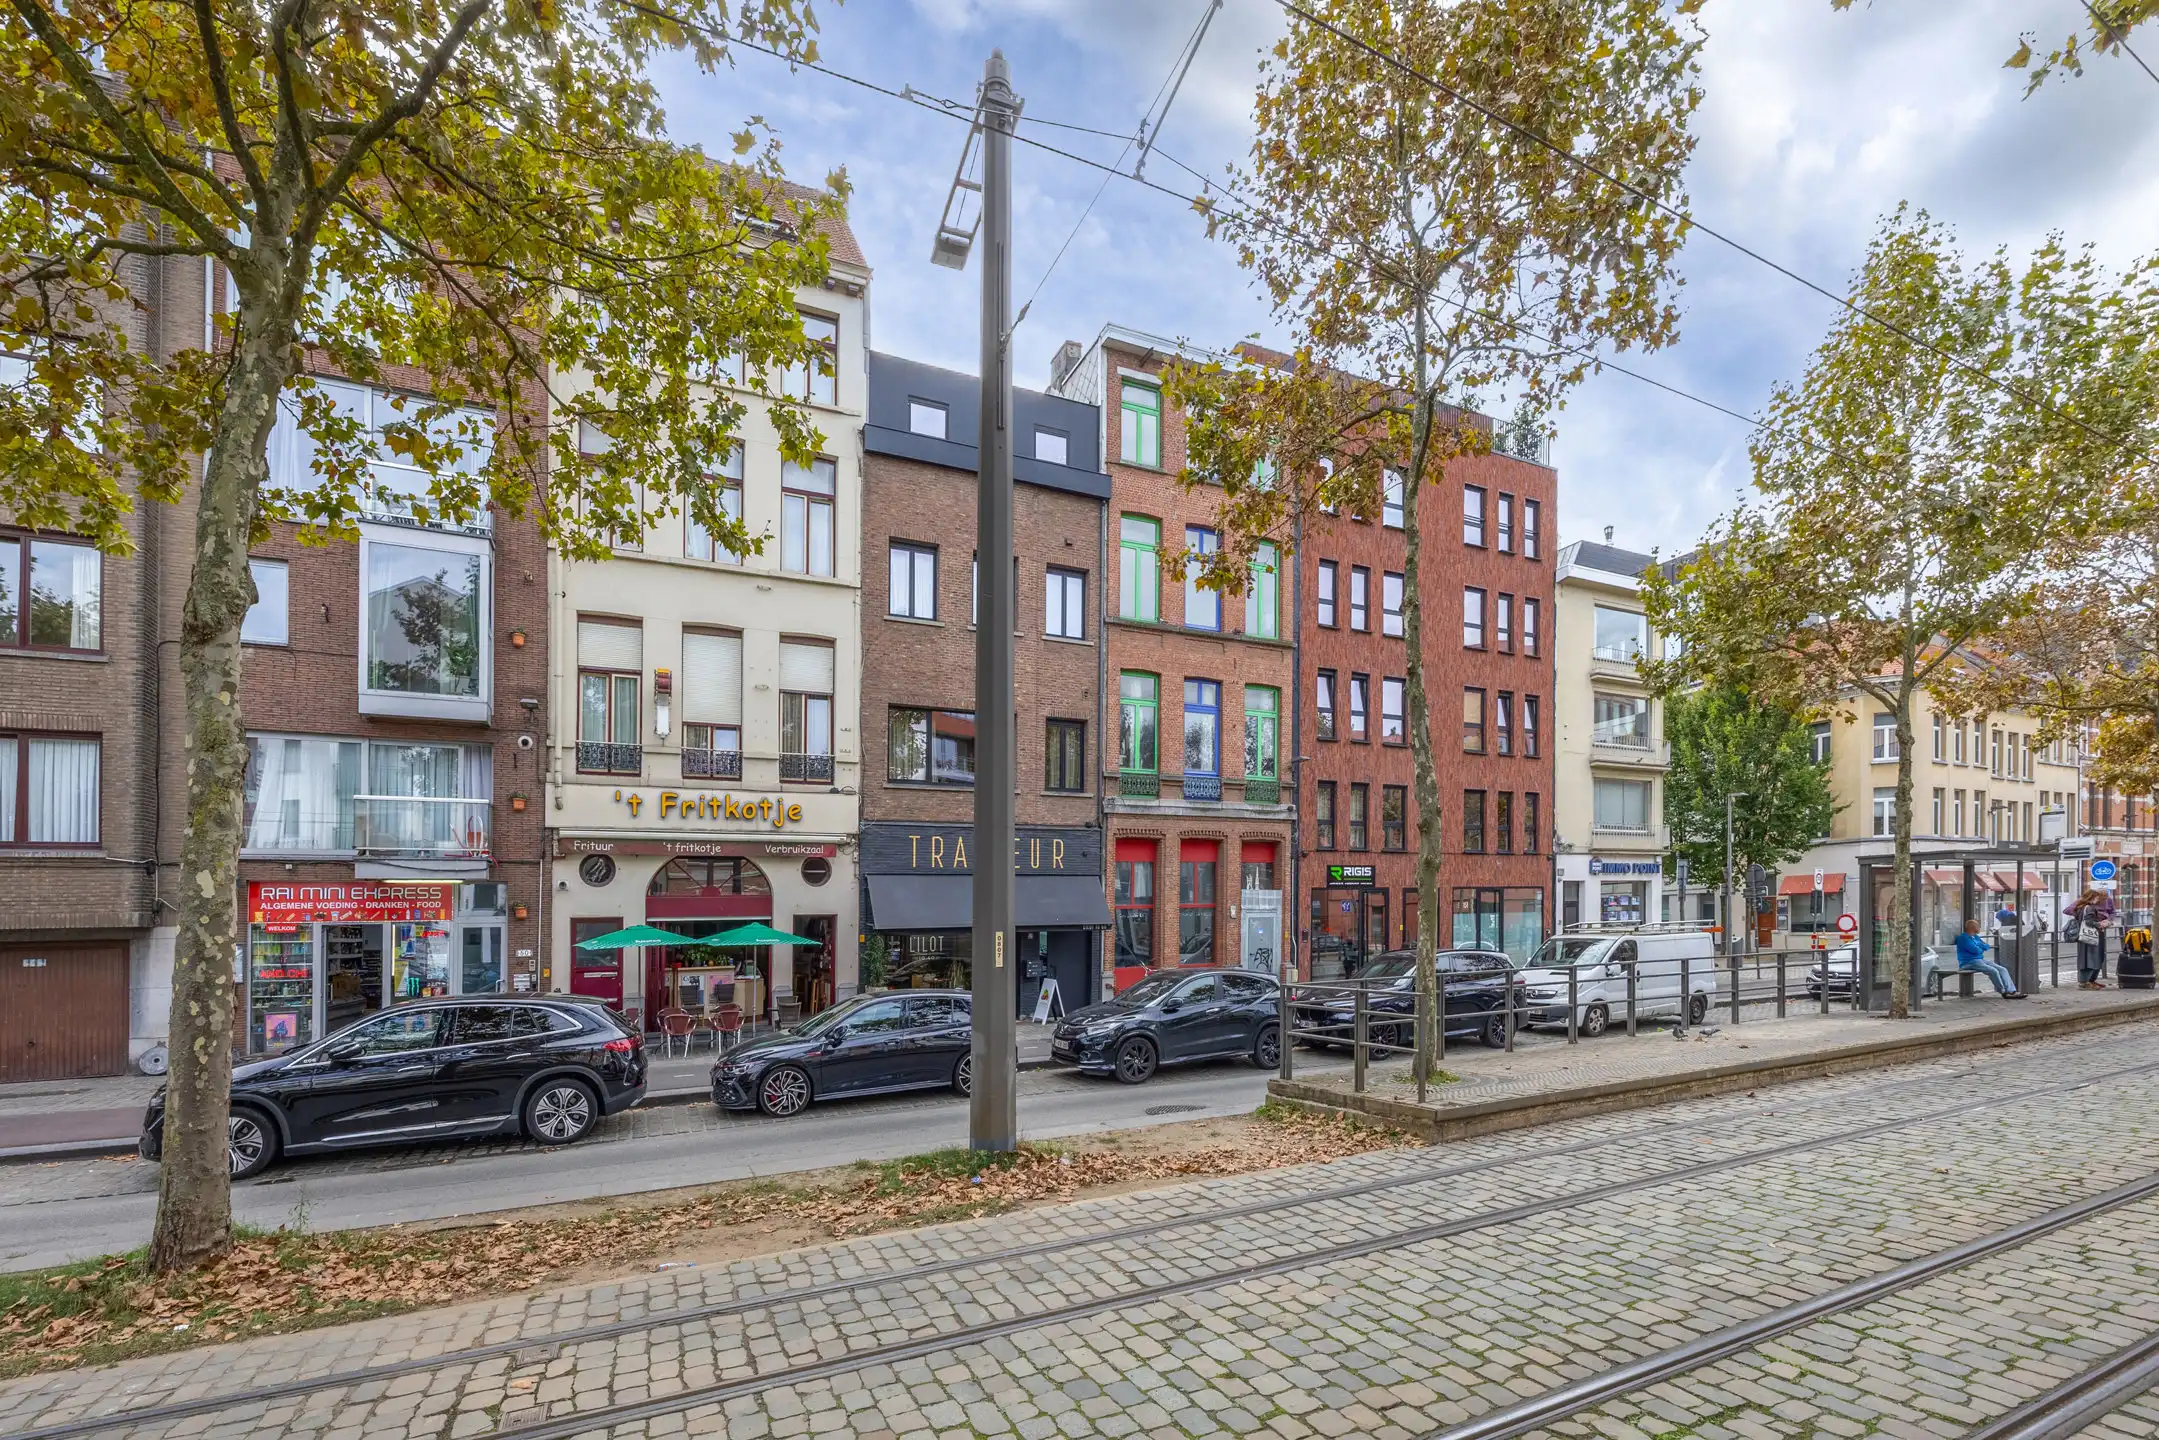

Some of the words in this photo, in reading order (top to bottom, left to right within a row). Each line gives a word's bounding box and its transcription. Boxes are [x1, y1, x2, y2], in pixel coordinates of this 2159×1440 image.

[614, 790, 643, 817] 't
[660, 792, 803, 828] Fritkotje
[573, 840, 614, 851] Frituur
[662, 842, 672, 852] 't
[675, 842, 722, 854] fritkotje
[765, 844, 824, 854] Verbruikzaal
[909, 835, 1064, 869] TRAEUR
[1343, 867, 1372, 877] RIGIS
[1602, 863, 1631, 874] IMMO
[1632, 863, 1660, 874] POINT
[260, 887, 294, 900] RAI
[299, 887, 345, 900] MINI
[351, 887, 442, 900] EXPRESS
[260, 902, 313, 910] ALGEMENE
[316, 901, 358, 909] VOEDING
[365, 901, 410, 909] DRANKEN
[416, 901, 442, 909] FOOD
[909, 935, 945, 953] L'ILOT
